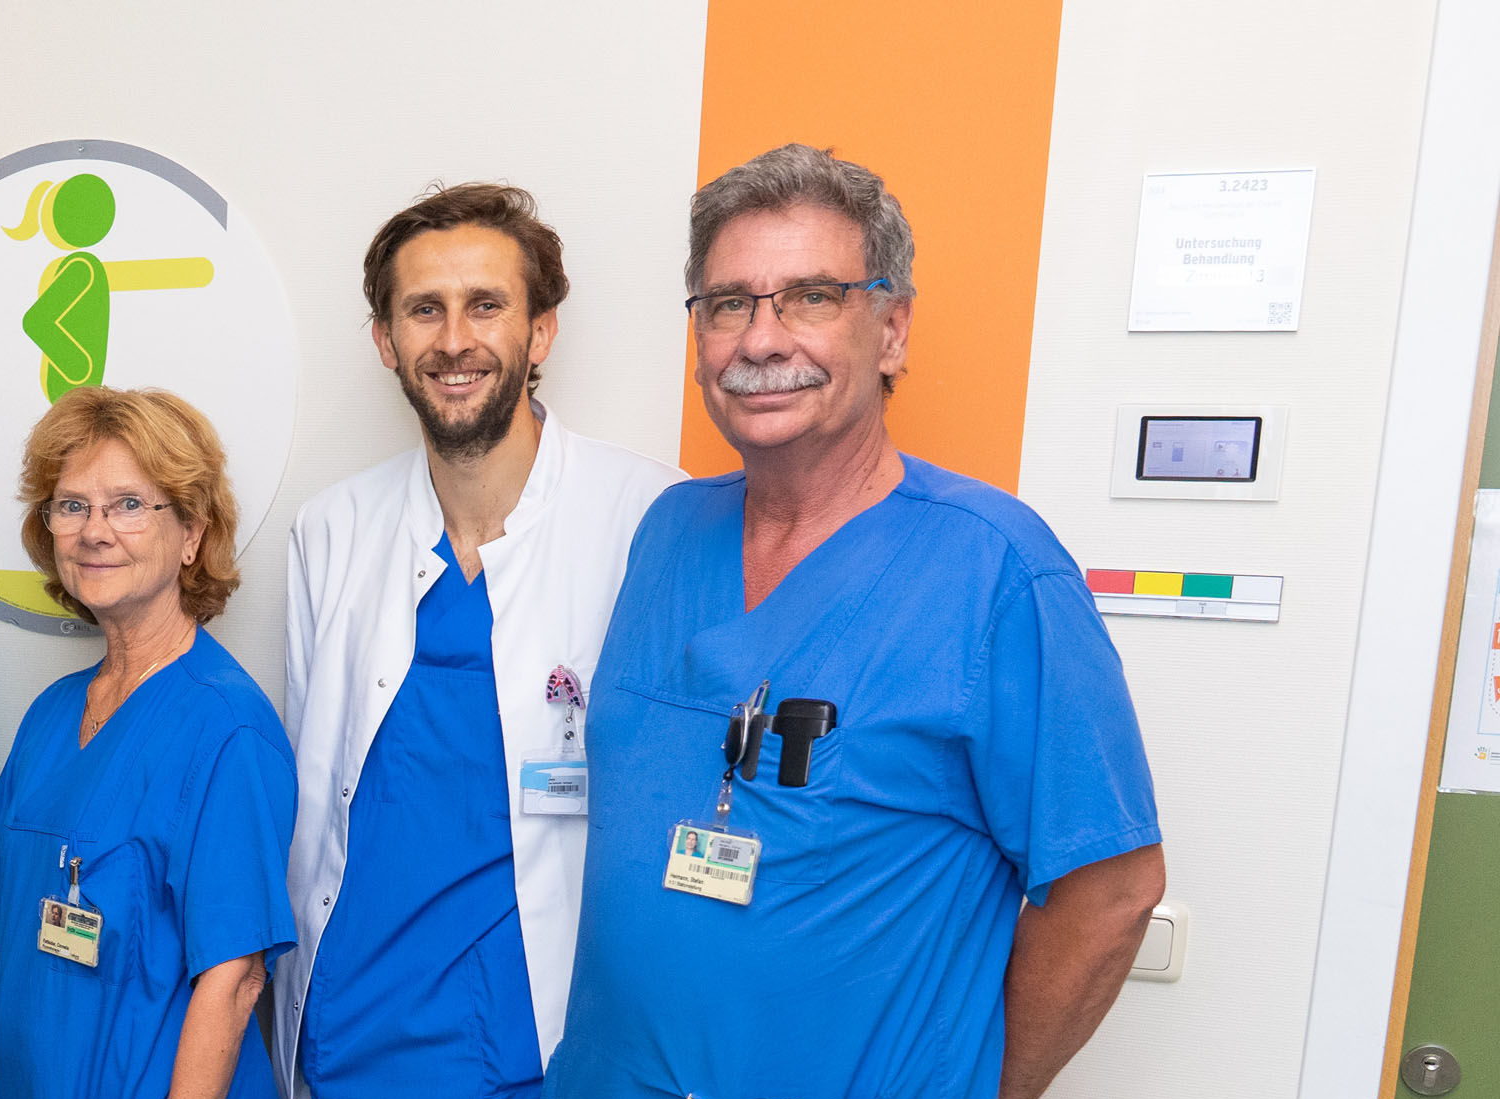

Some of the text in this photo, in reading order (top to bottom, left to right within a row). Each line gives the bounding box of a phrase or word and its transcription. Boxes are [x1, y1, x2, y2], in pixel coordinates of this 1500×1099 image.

[1219, 179, 1269, 192] 3.2423
[1175, 237, 1263, 250] Untersuchung
[1182, 253, 1255, 265] Behandlung
